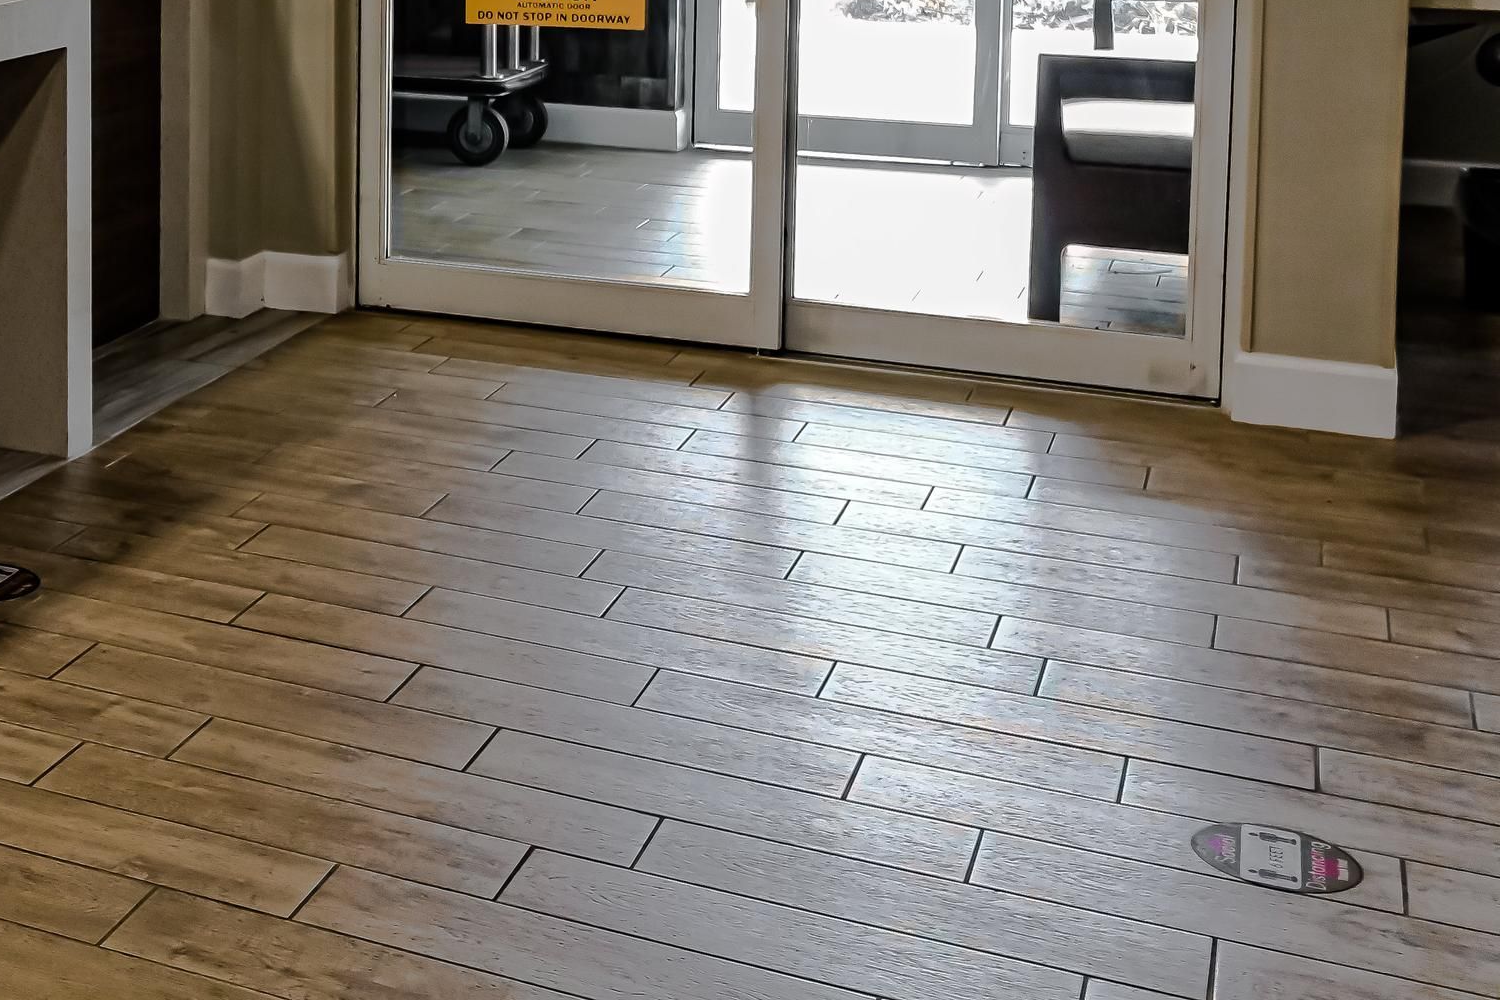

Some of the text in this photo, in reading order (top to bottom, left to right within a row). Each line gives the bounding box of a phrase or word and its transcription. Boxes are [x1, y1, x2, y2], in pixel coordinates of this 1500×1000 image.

[477, 11, 631, 24] DO NOT STOP IN DOORWAY
[1306, 841, 1331, 891] Distancing
